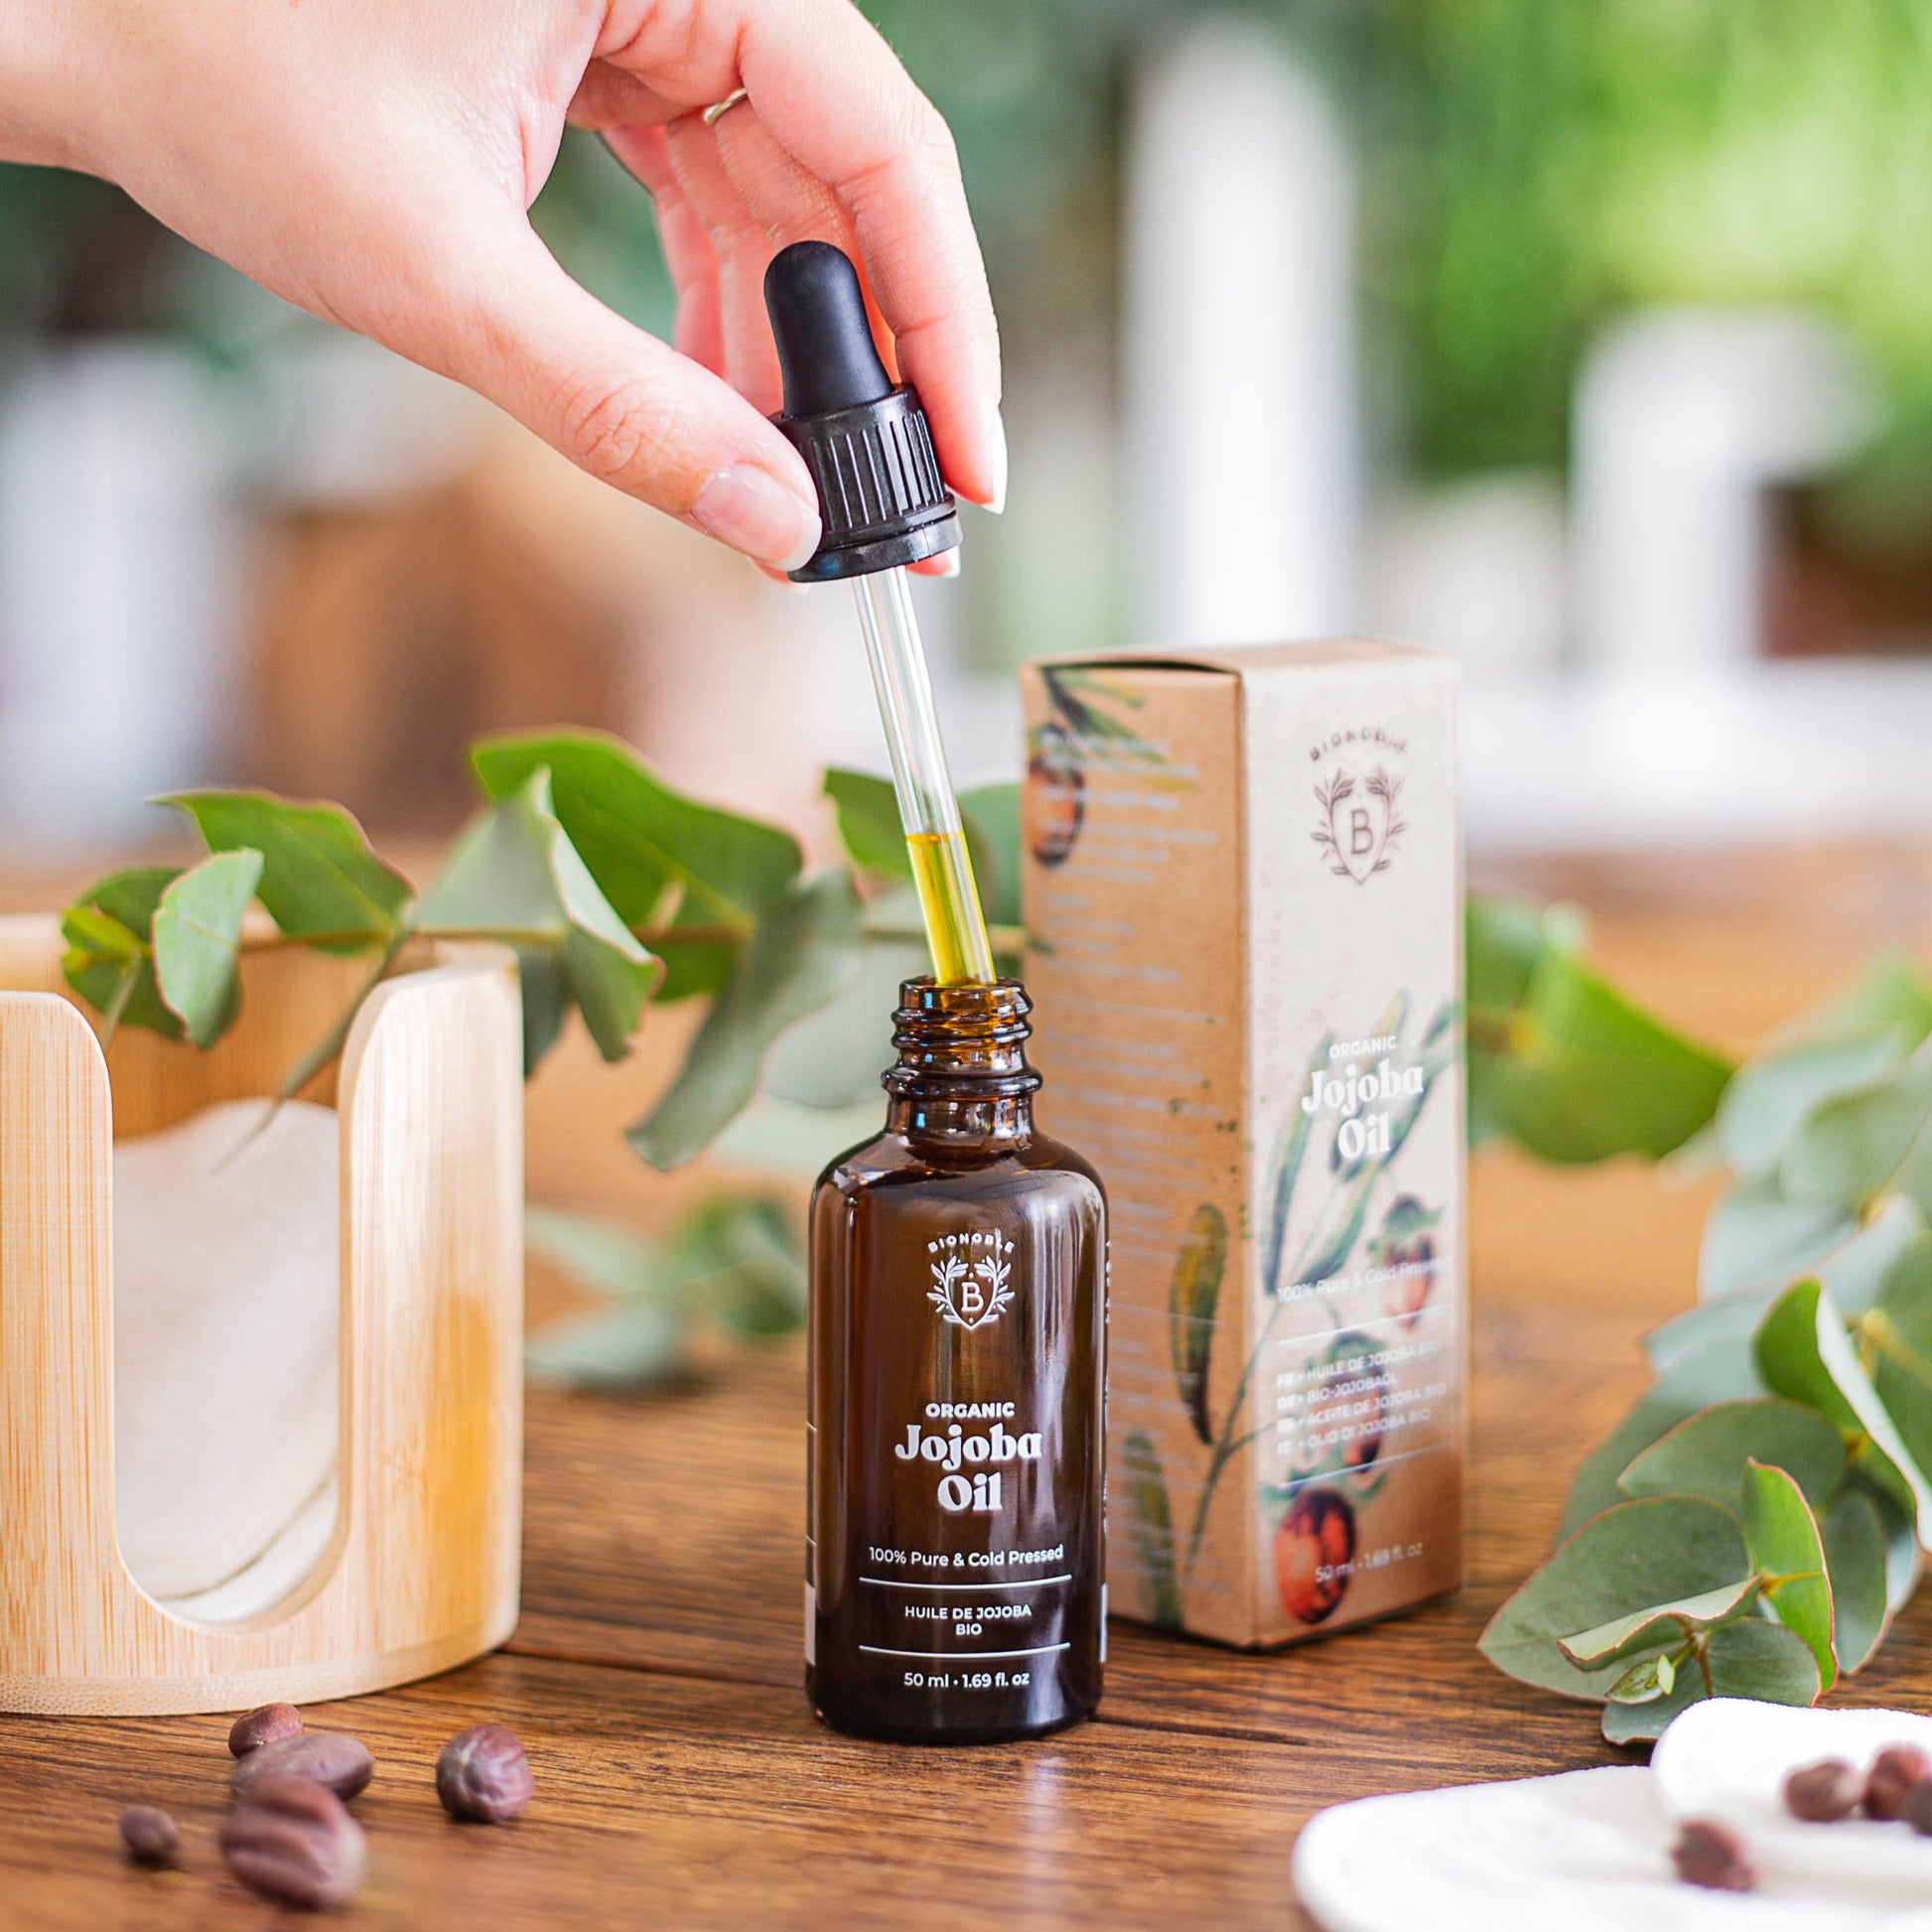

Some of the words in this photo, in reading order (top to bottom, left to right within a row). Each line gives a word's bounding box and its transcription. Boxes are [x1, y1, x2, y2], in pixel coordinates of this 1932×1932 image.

[1350, 808, 1374, 855] B
[1328, 1035, 1397, 1059] ORGANIC
[1301, 1057, 1424, 1115] Jojoba
[1338, 1111, 1391, 1159] Oil
[927, 1232, 1015, 1253] BIONOBLE
[961, 1282, 984, 1311] B
[1277, 1282, 1312, 1304] 100%
[1316, 1277, 1350, 1296] Pure
[1352, 1272, 1363, 1288] &
[1365, 1264, 1396, 1285] Cold
[1307, 1361, 1345, 1381] HUILE
[1348, 1357, 1366, 1372] DE
[1368, 1347, 1416, 1367] JOJOBA
[925, 1402, 1015, 1419] ORGANIC
[1307, 1405, 1351, 1426] ACEITE
[1354, 1400, 1372, 1415] DE
[1374, 1388, 1422, 1410] JOJOBA
[1357, 1414, 1406, 1436] JOJOBA
[895, 1423, 1042, 1470] Jojoba
[937, 1472, 1003, 1511] Oil
[869, 1546, 906, 1565] 100%
[910, 1551, 948, 1568] Pure
[953, 1552, 965, 1567] &
[968, 1550, 1004, 1567] Cold
[1009, 1544, 1063, 1565] Pressed
[1315, 1564, 1333, 1584] 50
[904, 1605, 948, 1619] HUILE
[952, 1607, 973, 1619] DE
[976, 1604, 1032, 1619] JOJOBA
[955, 1623, 983, 1635] BIO
[903, 1672, 923, 1686] 50
[927, 1673, 949, 1687] ml
[961, 1673, 992, 1688] 1.69
[995, 1672, 1009, 1687] fl.
[1012, 1673, 1031, 1686] oz
